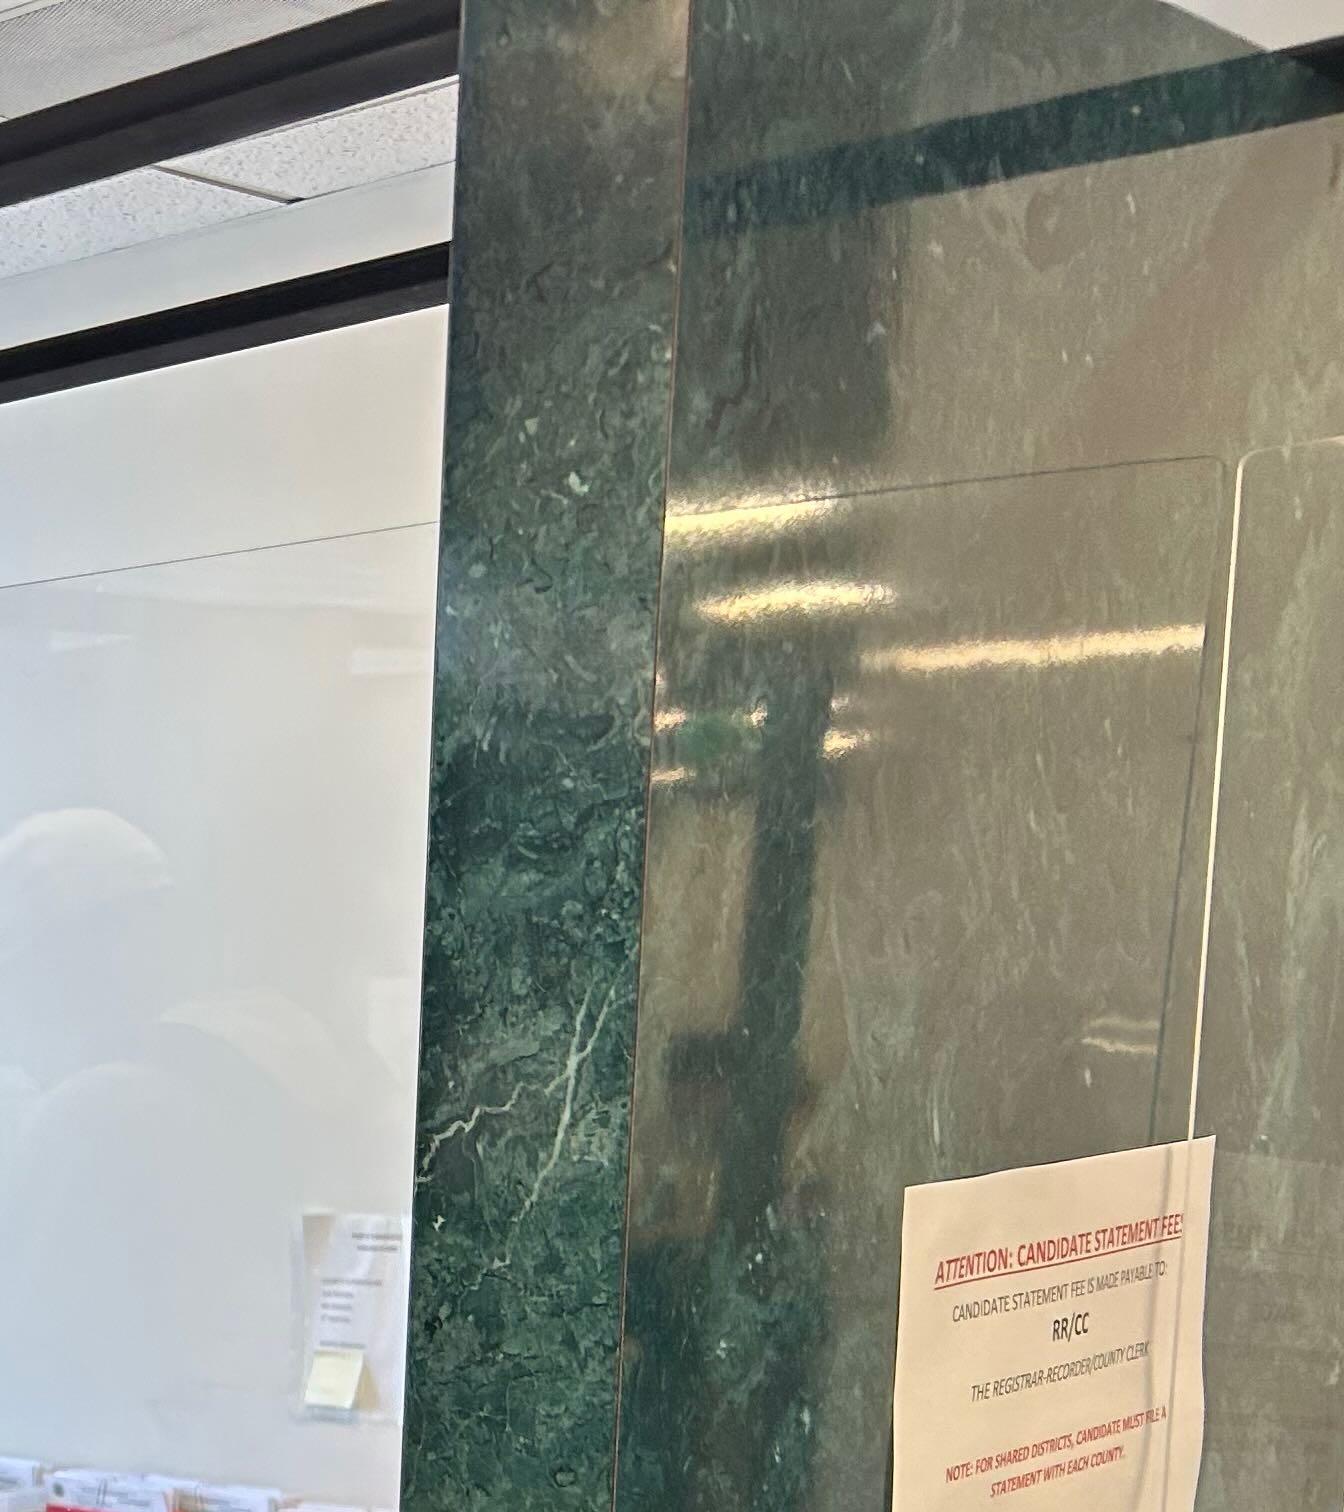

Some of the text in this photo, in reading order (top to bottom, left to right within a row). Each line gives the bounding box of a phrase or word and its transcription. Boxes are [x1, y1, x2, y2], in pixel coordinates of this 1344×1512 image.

[934, 1246, 1013, 1284] ATTENTION:
[1017, 1231, 1092, 1267] CANDIDATE
[1094, 1217, 1160, 1251] STATEMENT
[952, 1295, 1010, 1322] CANDIDATE
[1012, 1283, 1069, 1311] STATEMENT
[1070, 1280, 1086, 1298] FEE
[1087, 1277, 1095, 1294] IS
[1096, 1271, 1120, 1292] MADE
[1120, 1264, 1154, 1286] PAYABLE
[1052, 1312, 1090, 1342] RR/CC
[971, 1341, 1150, 1402] THE REGISTRAR-RECORDER/COUNTY CLERK
[945, 1405, 1167, 1484] NOTE: FOR SHARED DISTRICTS, CANDIDATE MUST FILE A
[990, 1469, 1043, 1498] STATEMENT
[1043, 1461, 1066, 1482] WITH
[1066, 1455, 1090, 1475] EACH
